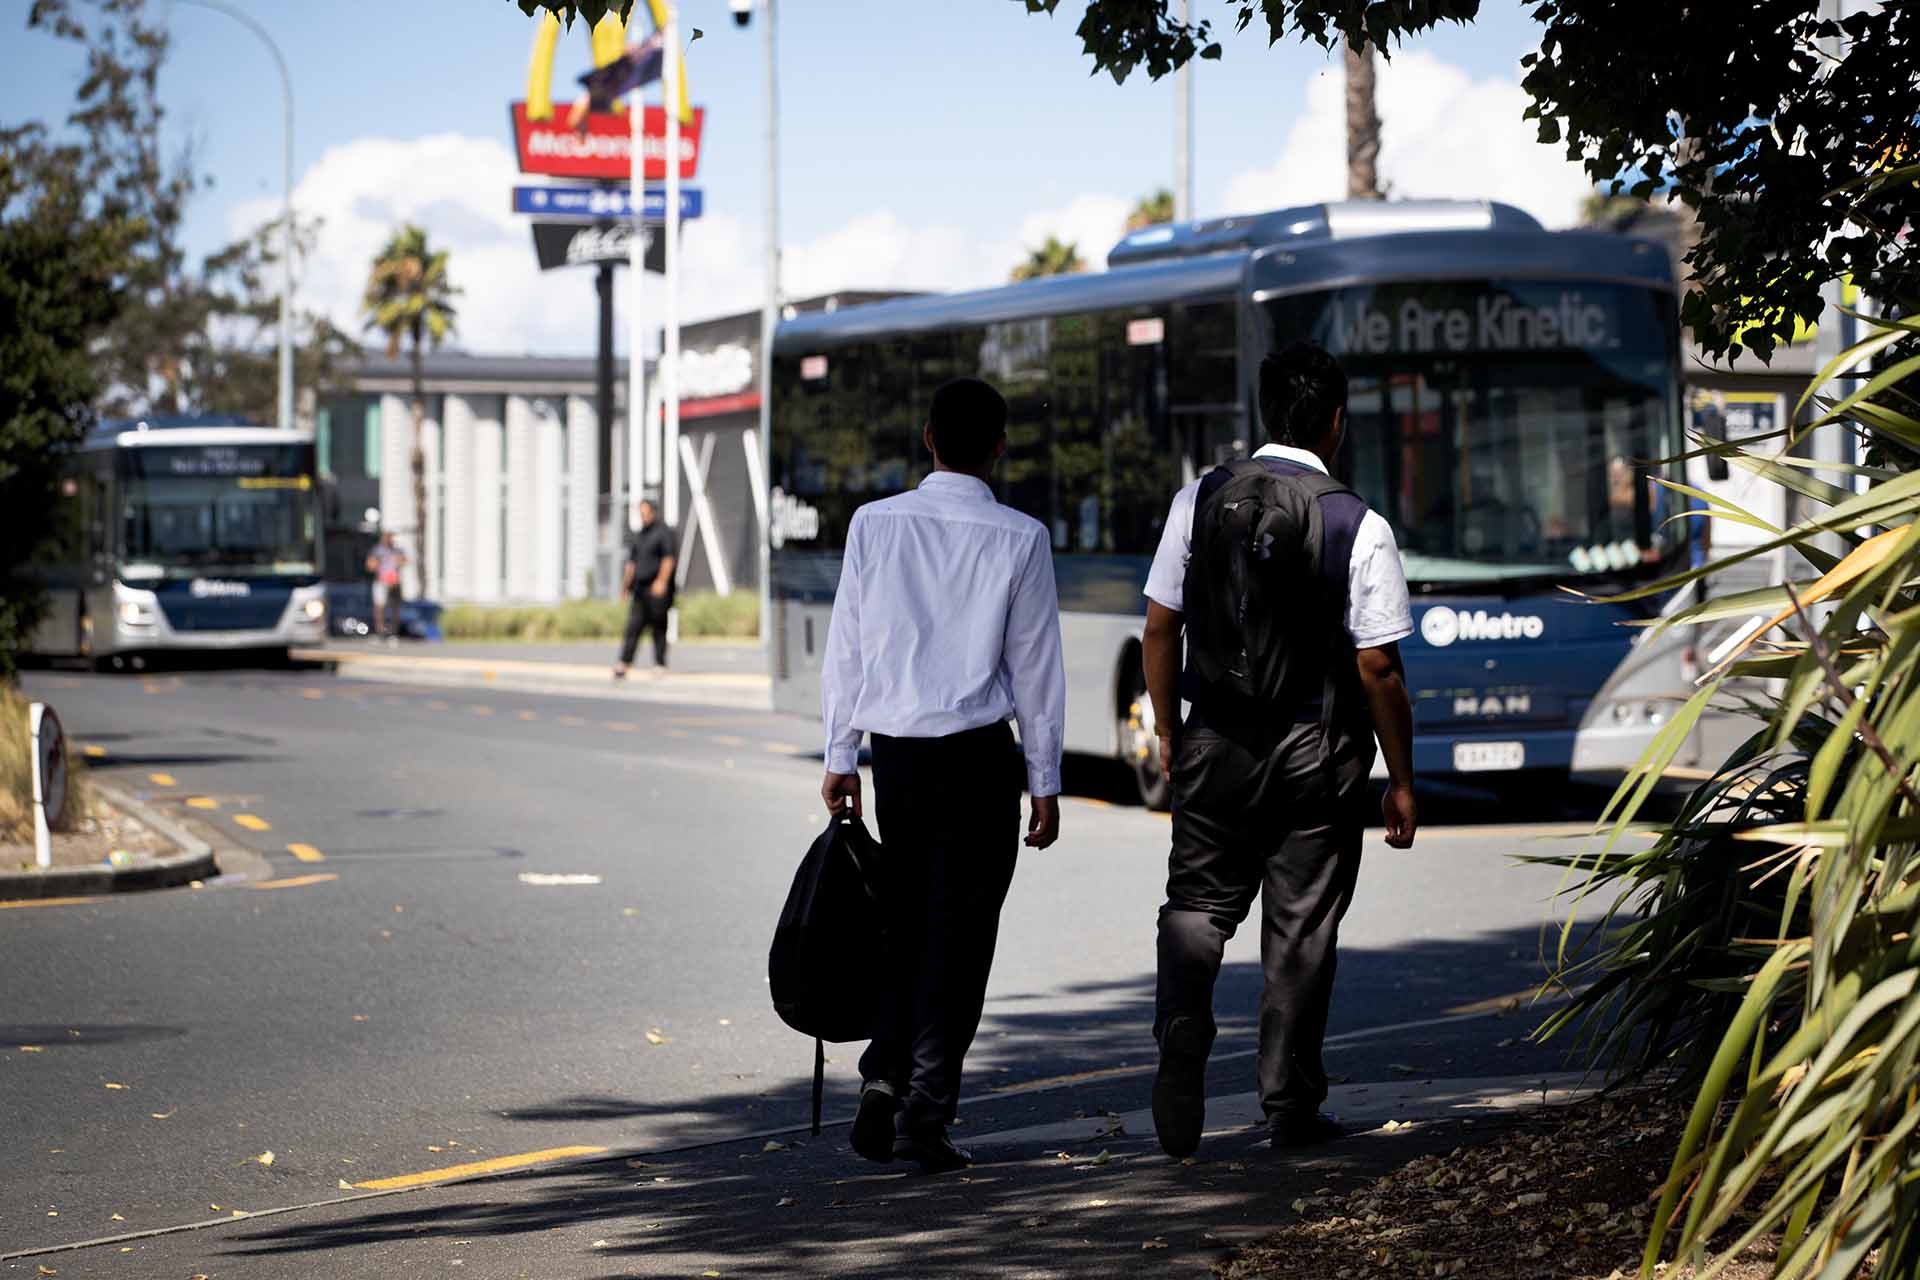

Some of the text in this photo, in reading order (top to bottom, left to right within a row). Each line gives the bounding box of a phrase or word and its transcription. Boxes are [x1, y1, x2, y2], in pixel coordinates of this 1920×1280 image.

[1332, 299, 1391, 353] We
[1399, 298, 1470, 351] Are
[1458, 610, 1544, 640] Metro
